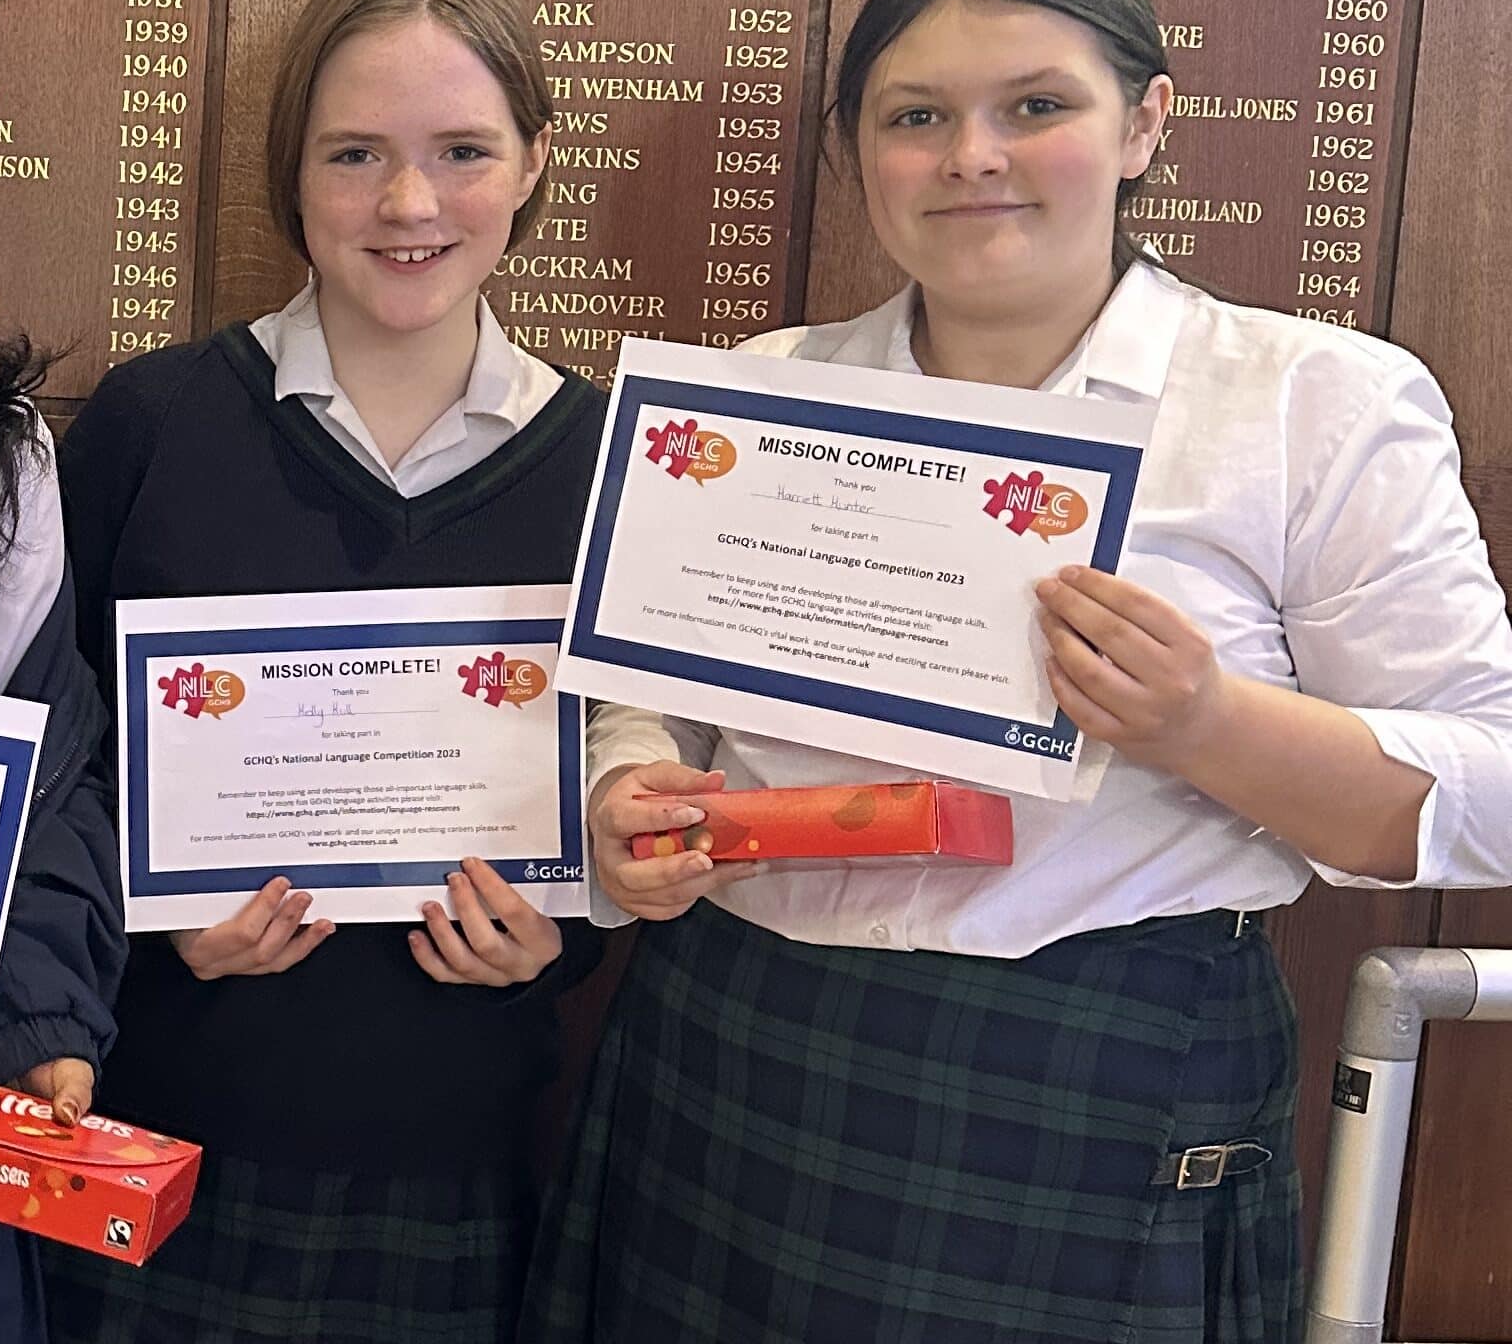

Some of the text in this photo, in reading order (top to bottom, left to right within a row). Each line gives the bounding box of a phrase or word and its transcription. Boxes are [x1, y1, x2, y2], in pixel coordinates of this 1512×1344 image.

[123, 90, 186, 114] 1940
[581, 78, 781, 104] WENHAM 1953
[1230, 98, 1373, 125] JONES 1961
[120, 161, 182, 184] 1942
[1306, 205, 1365, 228] 1963
[116, 231, 176, 252] 1945
[493, 255, 770, 286] COCKRAM 1956
[510, 292, 768, 320] HANDOVER 1956
[665, 432, 724, 461] NLC
[694, 462, 718, 471] GCHQ
[759, 437, 965, 482] MISSION COMPLETE!
[1006, 485, 1073, 517] NLC
[1039, 518, 1066, 528] GCHQ
[718, 534, 964, 584] GCHQ's National Language Competition 2023
[262, 659, 439, 678] MISSION COMPLETE!
[480, 664, 531, 686] NLC
[179, 675, 230, 698] NLC
[244, 749, 460, 765] GCHQ's National Language Competition 2023
